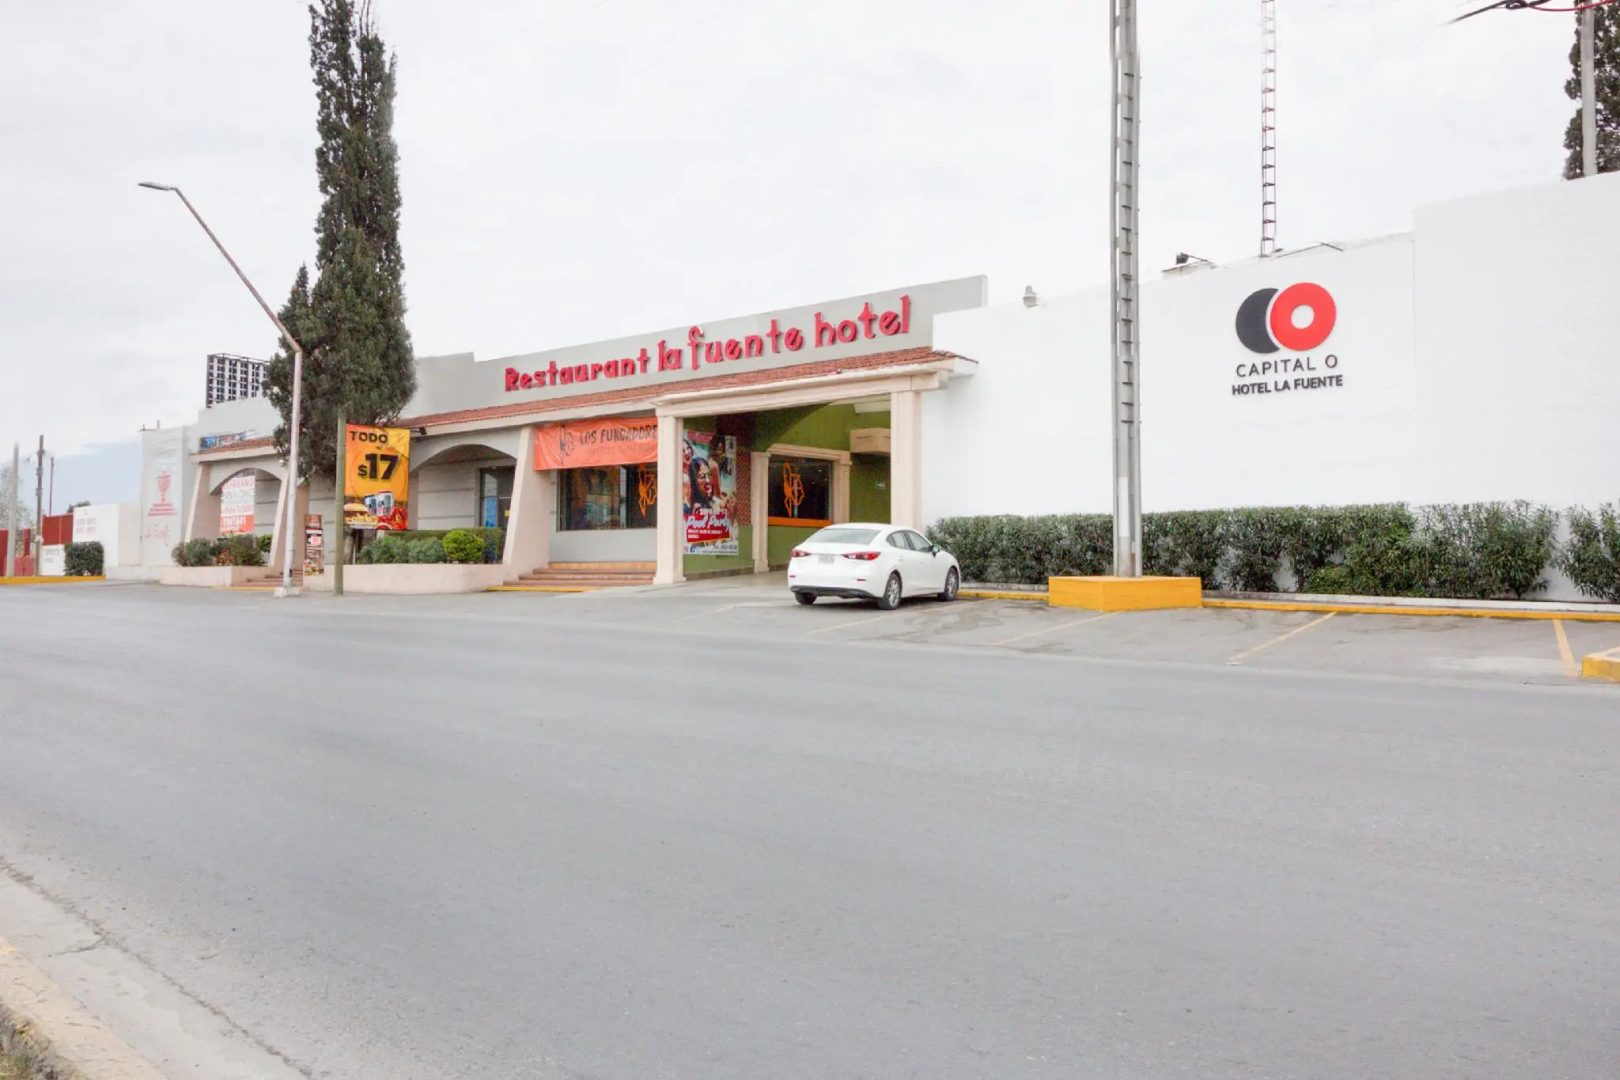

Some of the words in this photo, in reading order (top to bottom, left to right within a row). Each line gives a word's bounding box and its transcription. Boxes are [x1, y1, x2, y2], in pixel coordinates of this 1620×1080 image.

[505, 347, 649, 391] Restaurant
[658, 339, 681, 372] la
[687, 325, 804, 370] fuente
[814, 295, 911, 348] hotel
[1236, 356, 1317, 378] CAPITAL
[1325, 354, 1338, 369] O
[1232, 381, 1271, 396] HOTEL
[1274, 379, 1291, 392] LA
[1294, 374, 1343, 390] FUENTE
[349, 430, 389, 444] TODO
[580, 430, 597, 446] LOS
[357, 453, 399, 480] $17
